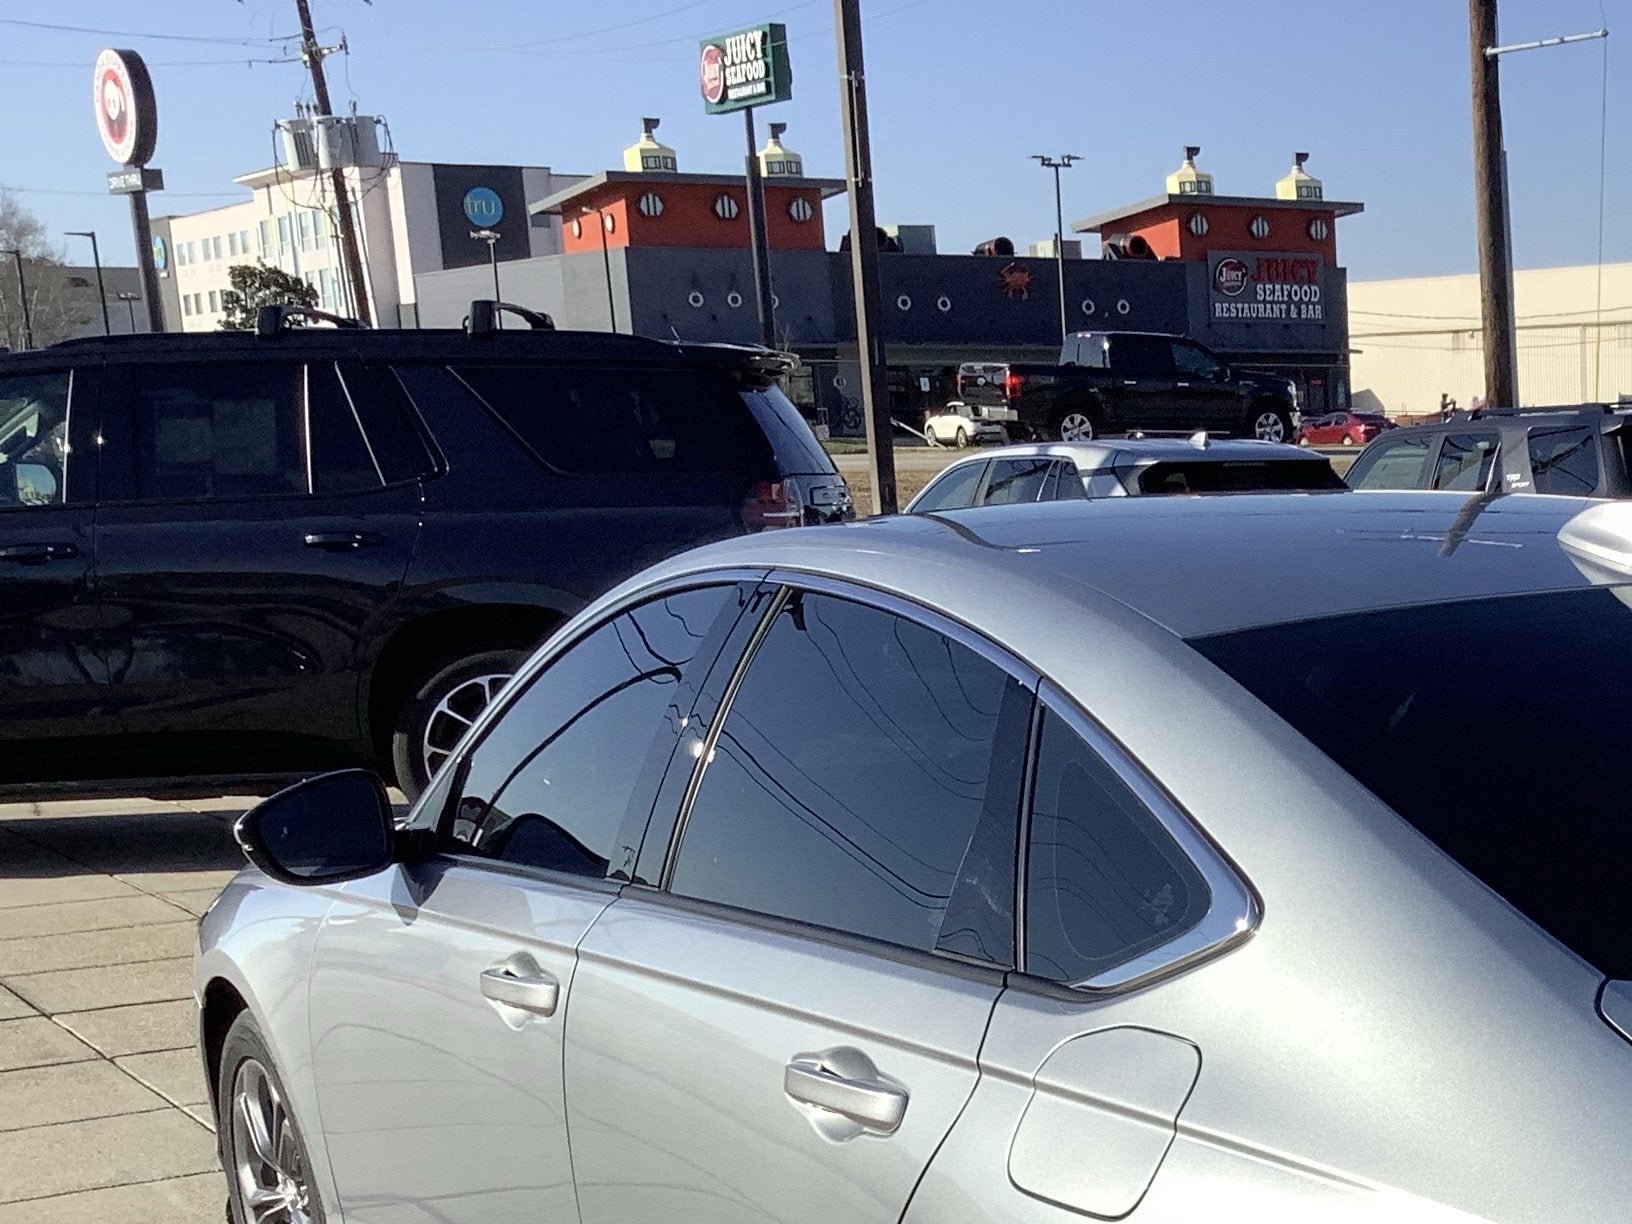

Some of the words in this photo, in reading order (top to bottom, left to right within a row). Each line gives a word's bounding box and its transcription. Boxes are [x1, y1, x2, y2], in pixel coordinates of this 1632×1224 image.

[723, 30, 763, 67] JUICY
[725, 59, 766, 87] SEAFOOD
[464, 196, 496, 215] tru
[1250, 258, 1317, 283] JUICY
[1256, 283, 1321, 302] SEAFOOD
[1214, 302, 1288, 318] RESTAURANT
[1289, 304, 1299, 319] &
[1300, 304, 1322, 319] BAR
